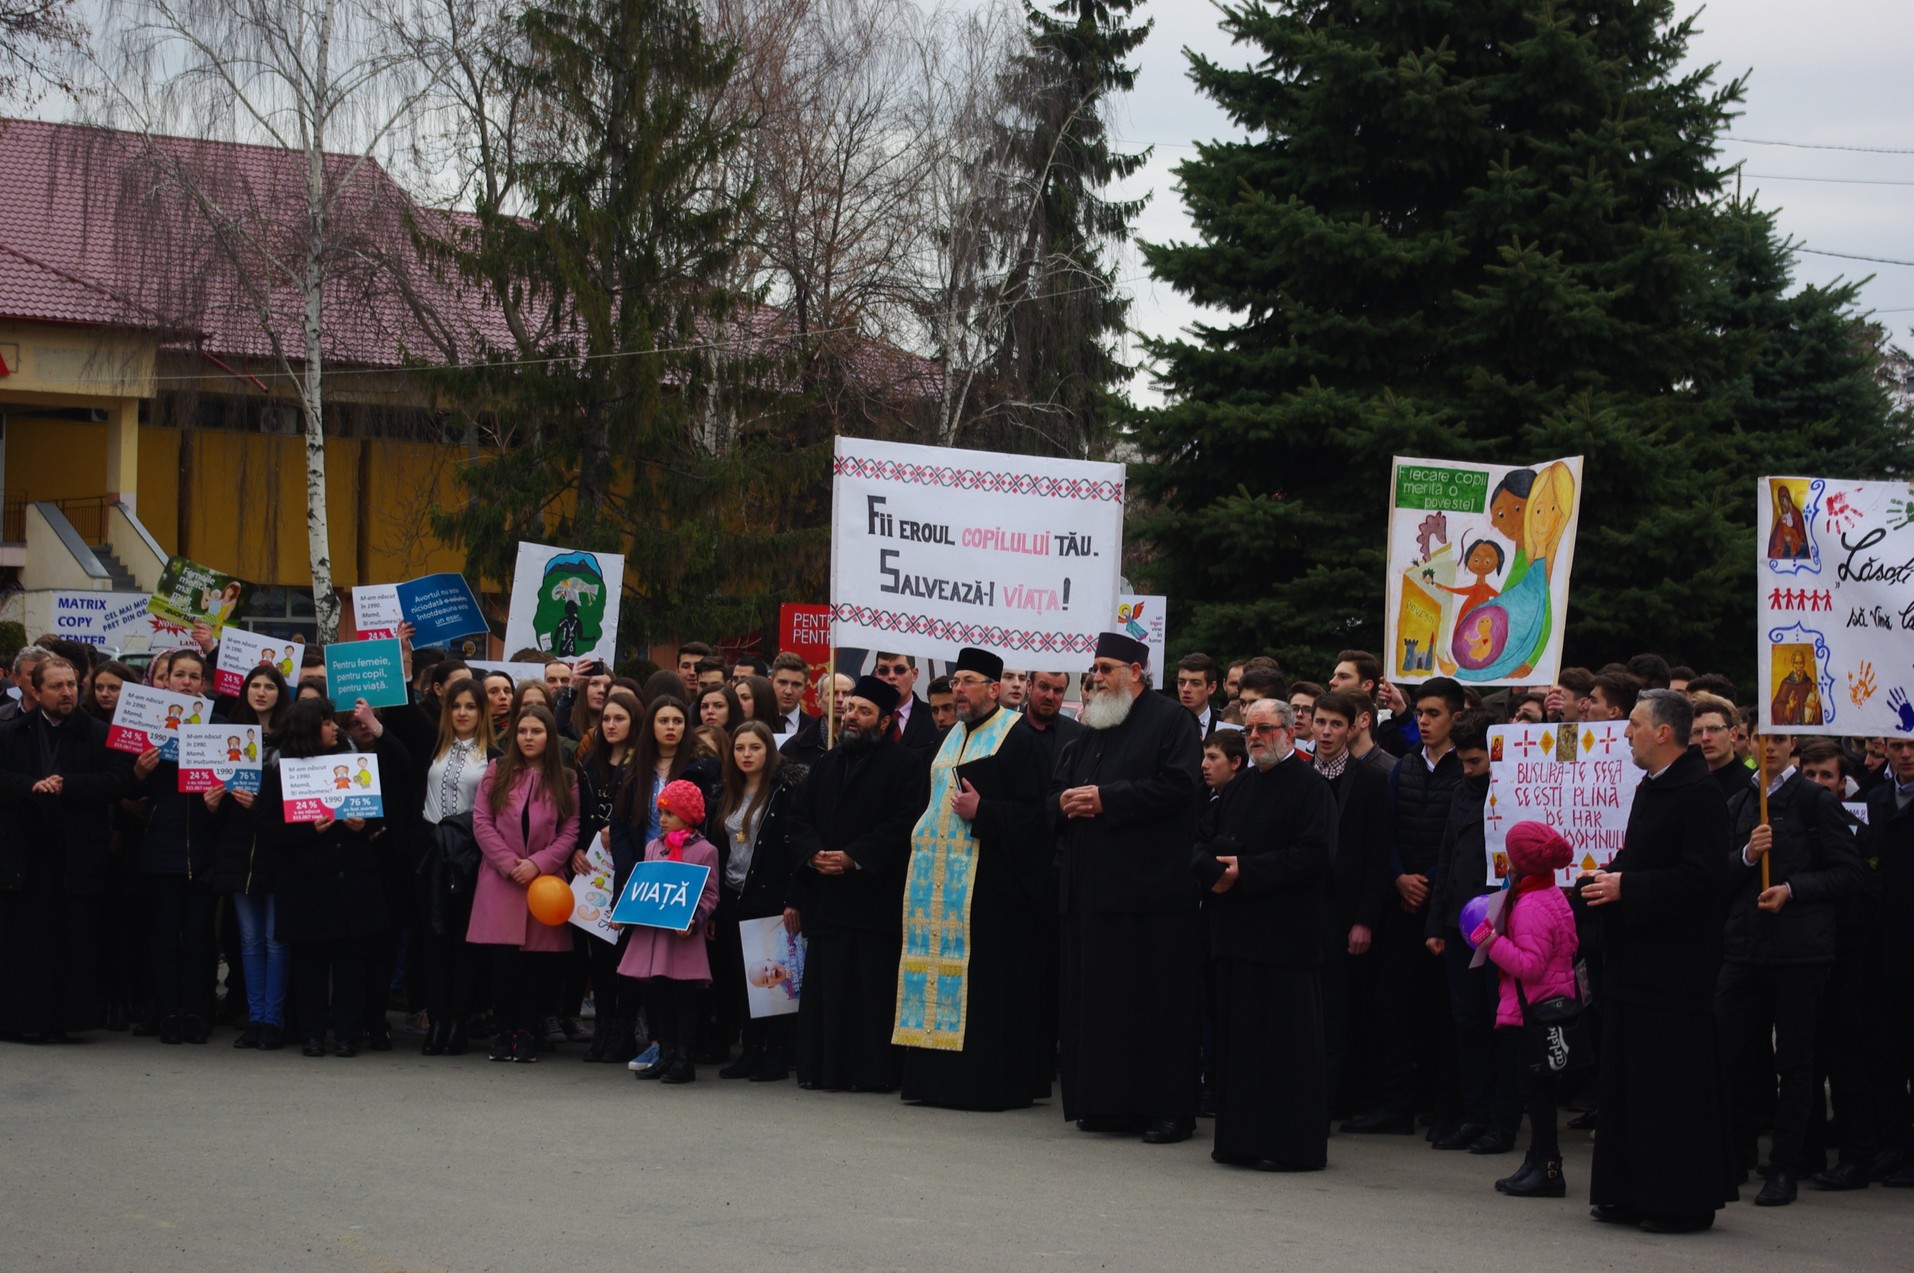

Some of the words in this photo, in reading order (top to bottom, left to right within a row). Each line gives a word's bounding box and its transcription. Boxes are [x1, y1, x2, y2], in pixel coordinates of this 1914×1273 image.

[1454, 472, 1487, 487] copil
[1448, 485, 1458, 496] o
[899, 519, 955, 546] EROUL
[1054, 531, 1100, 557] TĂU.
[415, 589, 441, 603] Avortul
[58, 597, 107, 610] MATRIX
[104, 610, 118, 621] CEL
[118, 604, 133, 615] MAI
[133, 598, 148, 609] MIC
[58, 616, 92, 628] COPY
[102, 620, 120, 632] PRET
[122, 613, 136, 624] DIN
[368, 632, 378, 640] 24
[332, 660, 356, 670] Pentru
[357, 656, 391, 667] femeie,
[224, 673, 232, 682] 24
[336, 672, 361, 683] pentru
[362, 668, 388, 680] copil,
[338, 684, 362, 695] pentru
[128, 692, 145, 701] M-am
[146, 695, 165, 705] născut
[121, 729, 133, 738] 24
[134, 732, 142, 741] %
[150, 732, 167, 742] 1990
[189, 771, 200, 779] 24
[201, 771, 209, 780] %
[239, 772, 249, 780] 76
[250, 772, 256, 780] %
[296, 801, 307, 809] 24
[309, 801, 317, 809] %
[350, 798, 361, 806] 76
[362, 797, 371, 806] %
[631, 881, 690, 910] VIAȚĂ
